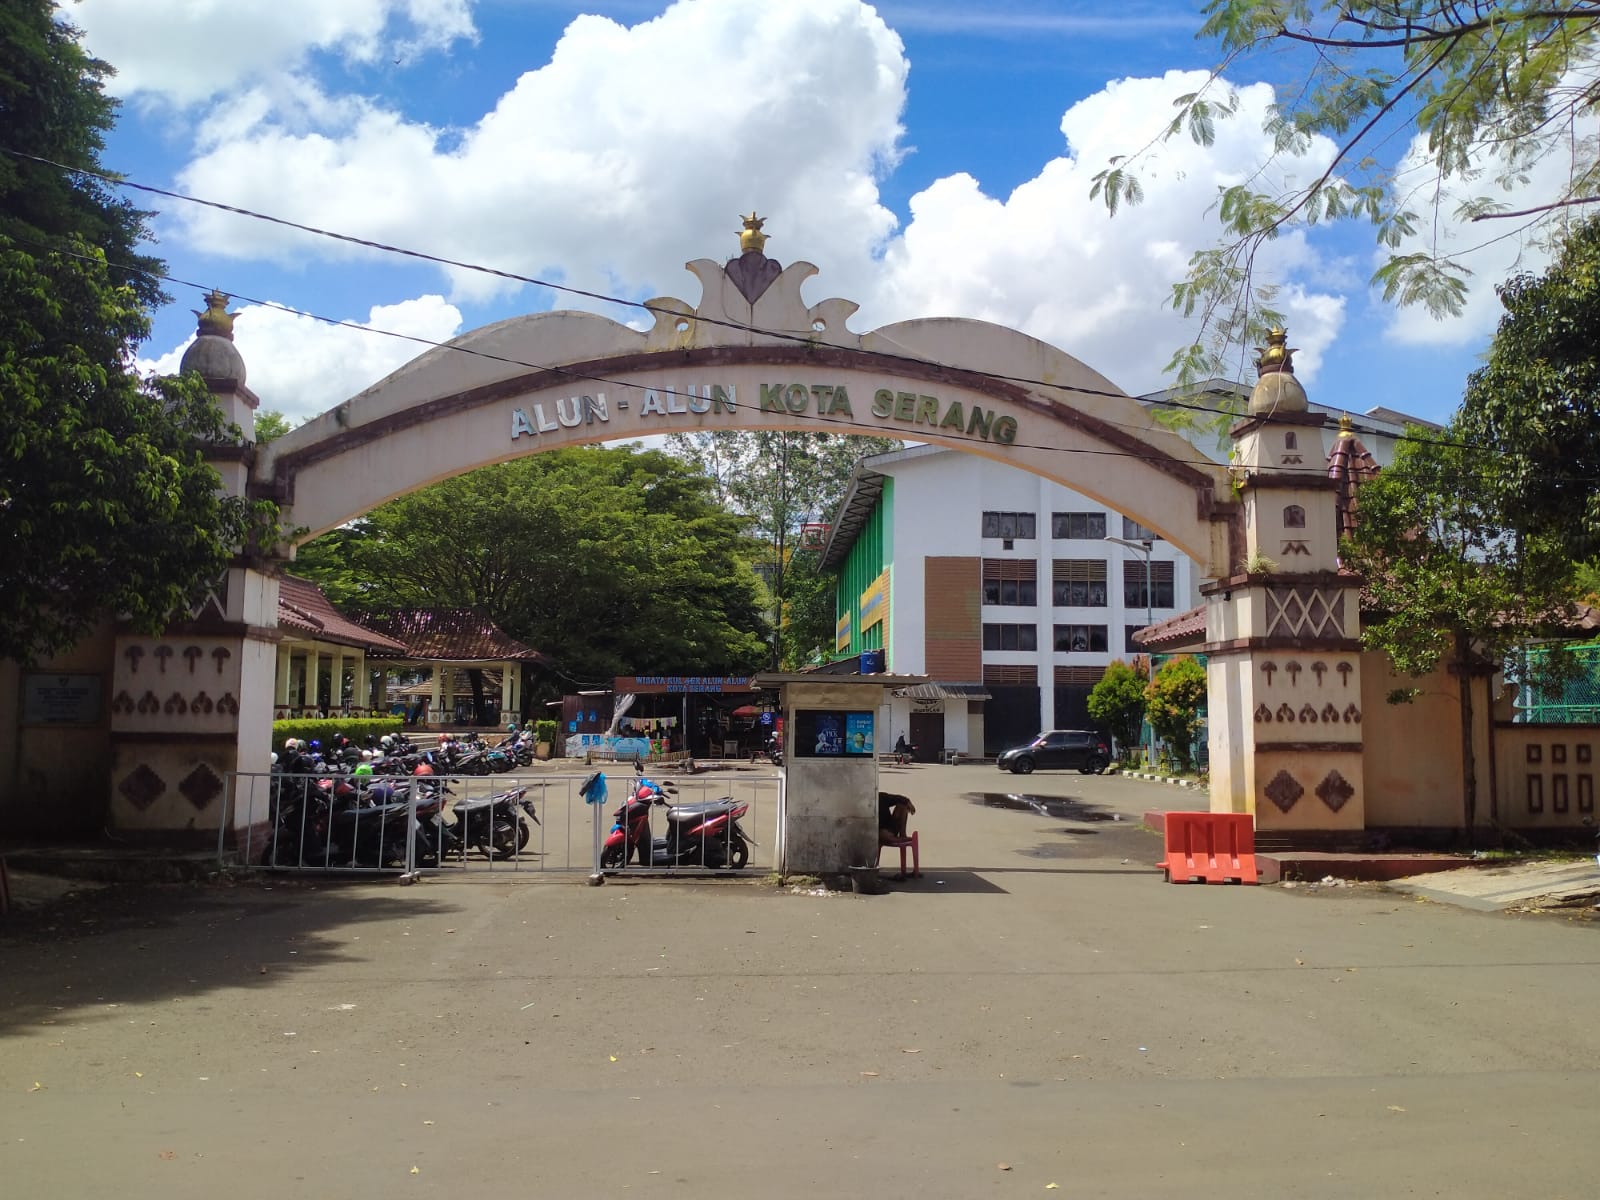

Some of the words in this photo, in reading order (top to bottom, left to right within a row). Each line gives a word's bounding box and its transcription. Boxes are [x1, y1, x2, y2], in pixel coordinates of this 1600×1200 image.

[511, 392, 609, 441] ALUN
[640, 384, 737, 417] ALUN
[759, 383, 853, 418] KOTA
[871, 388, 1018, 444] SERANG
